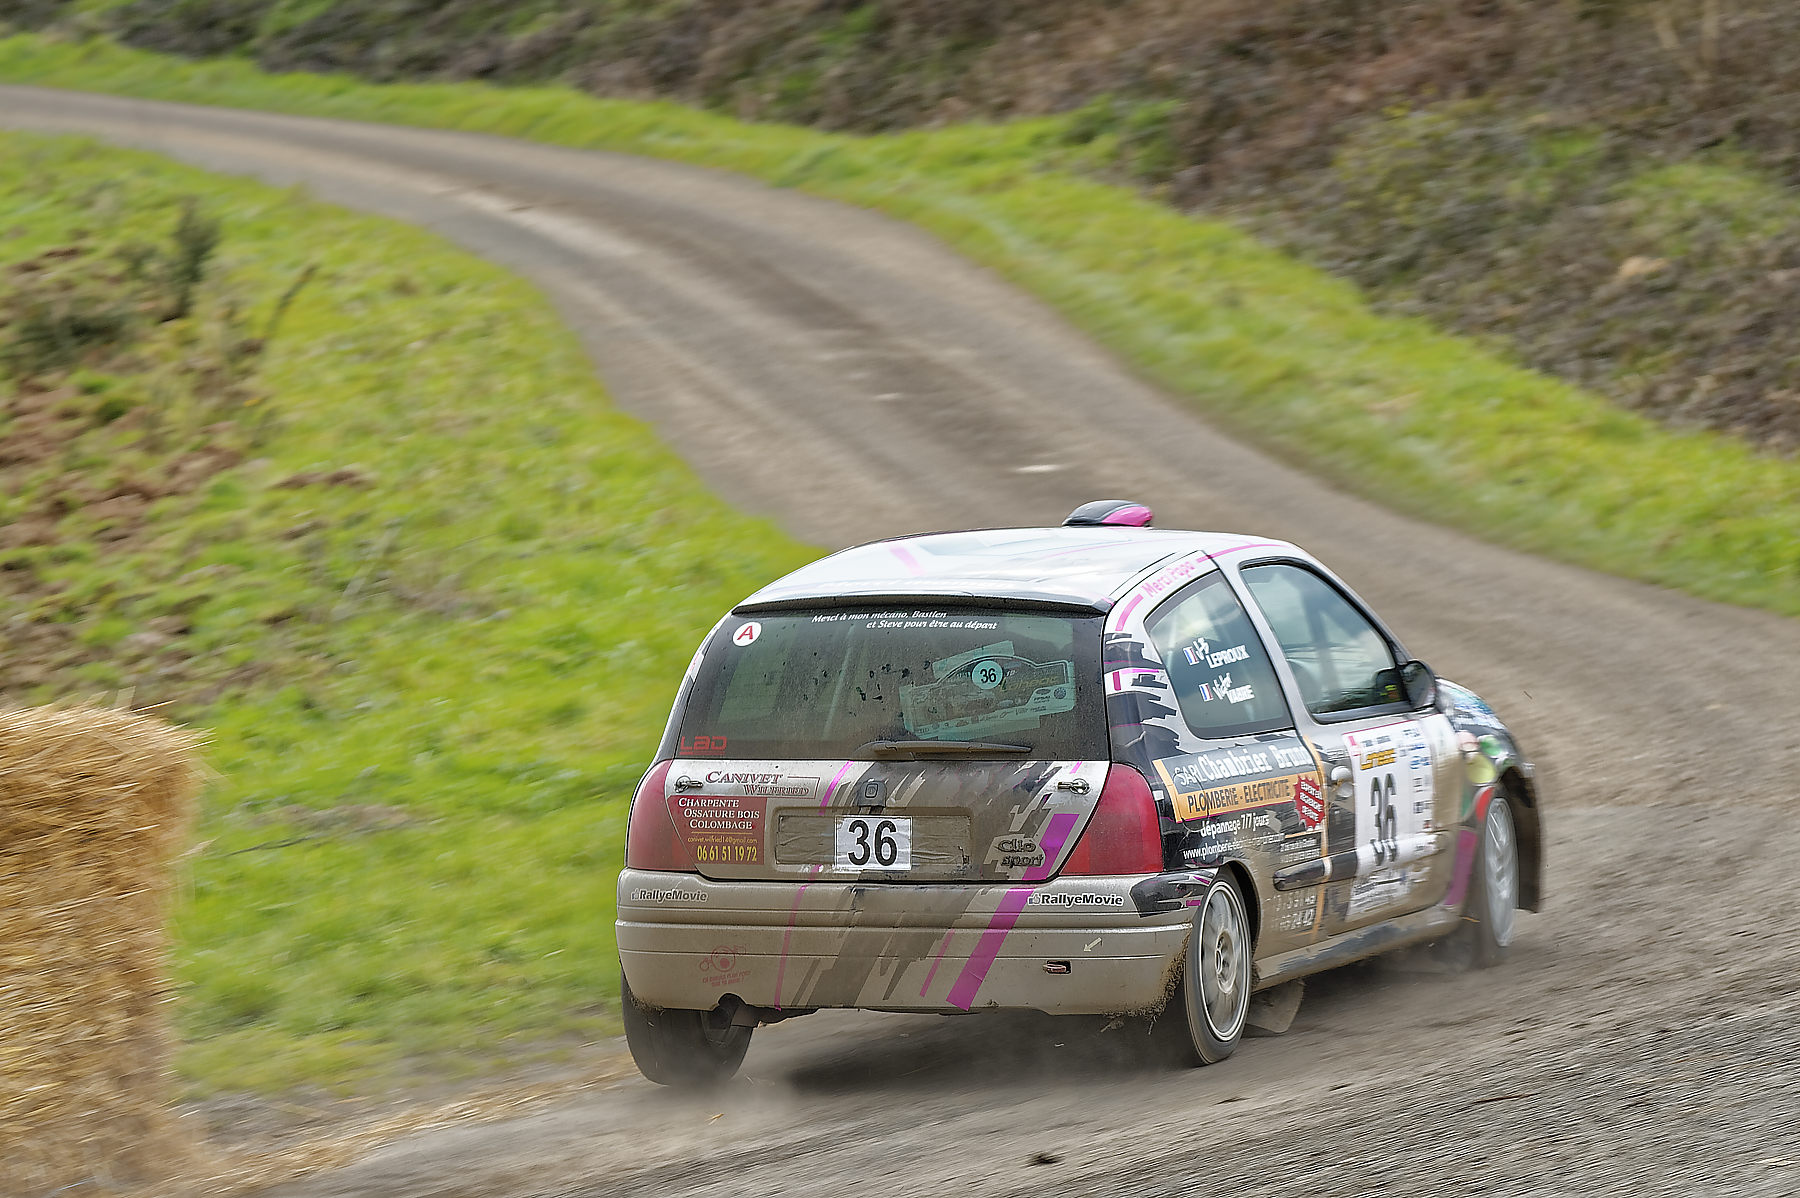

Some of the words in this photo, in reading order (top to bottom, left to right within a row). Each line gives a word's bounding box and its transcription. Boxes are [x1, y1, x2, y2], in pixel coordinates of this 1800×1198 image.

[1142, 574, 1171, 598] Merci
[811, 613, 839, 623] Merci
[848, 612, 869, 620] mon
[911, 610, 947, 619] Bastien
[866, 621, 877, 629] et
[877, 619, 903, 629] Steve
[903, 620, 927, 630] pour
[928, 619, 949, 628] être
[949, 621, 963, 629] au
[964, 620, 997, 630] départ
[736, 625, 753, 641] A
[1206, 644, 1250, 669] LEPROUX
[979, 667, 997, 684] 36
[1174, 763, 1207, 786] SARL
[1198, 748, 1273, 781] Chambrier
[705, 770, 783, 784] CANIVET
[743, 784, 809, 796] WILFRIED
[678, 797, 740, 808] CHARPENTE
[1187, 787, 1239, 814] PLOMBERIE
[683, 808, 735, 819] OSSATURE
[737, 809, 760, 819] BOIS
[1370, 773, 1397, 866] 36
[689, 819, 753, 830] COLOMBAGE
[1200, 819, 1241, 840] dépannage
[1240, 813, 1253, 830] 7/7
[847, 819, 898, 866] 36
[998, 839, 1036, 853] Clio
[697, 845, 708, 862] 06
[709, 845, 719, 862] 61
[721, 845, 731, 862] 51
[735, 845, 745, 862] 19
[746, 845, 757, 862] 72
[1001, 853, 1044, 868] sport
[639, 889, 707, 902] RallyeMovie
[1041, 893, 1123, 907] RallyeMovie
